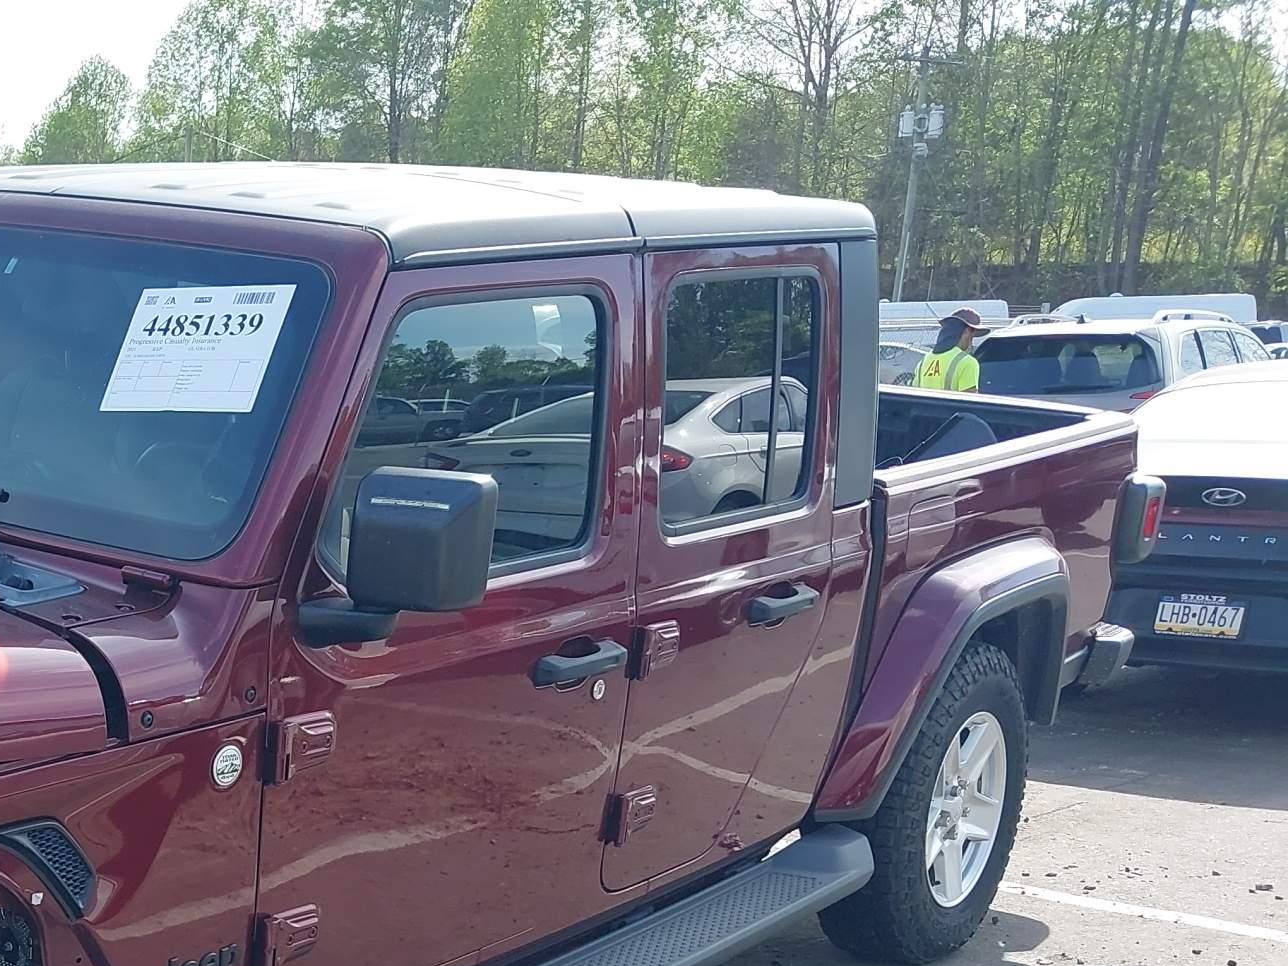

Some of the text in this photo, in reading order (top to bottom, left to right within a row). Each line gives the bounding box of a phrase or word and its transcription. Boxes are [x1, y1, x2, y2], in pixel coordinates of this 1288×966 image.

[142, 313, 264, 336] 44851339
[128, 337, 223, 347] Progressive Casualty Insurance
[1180, 593, 1227, 602] STOLTZ
